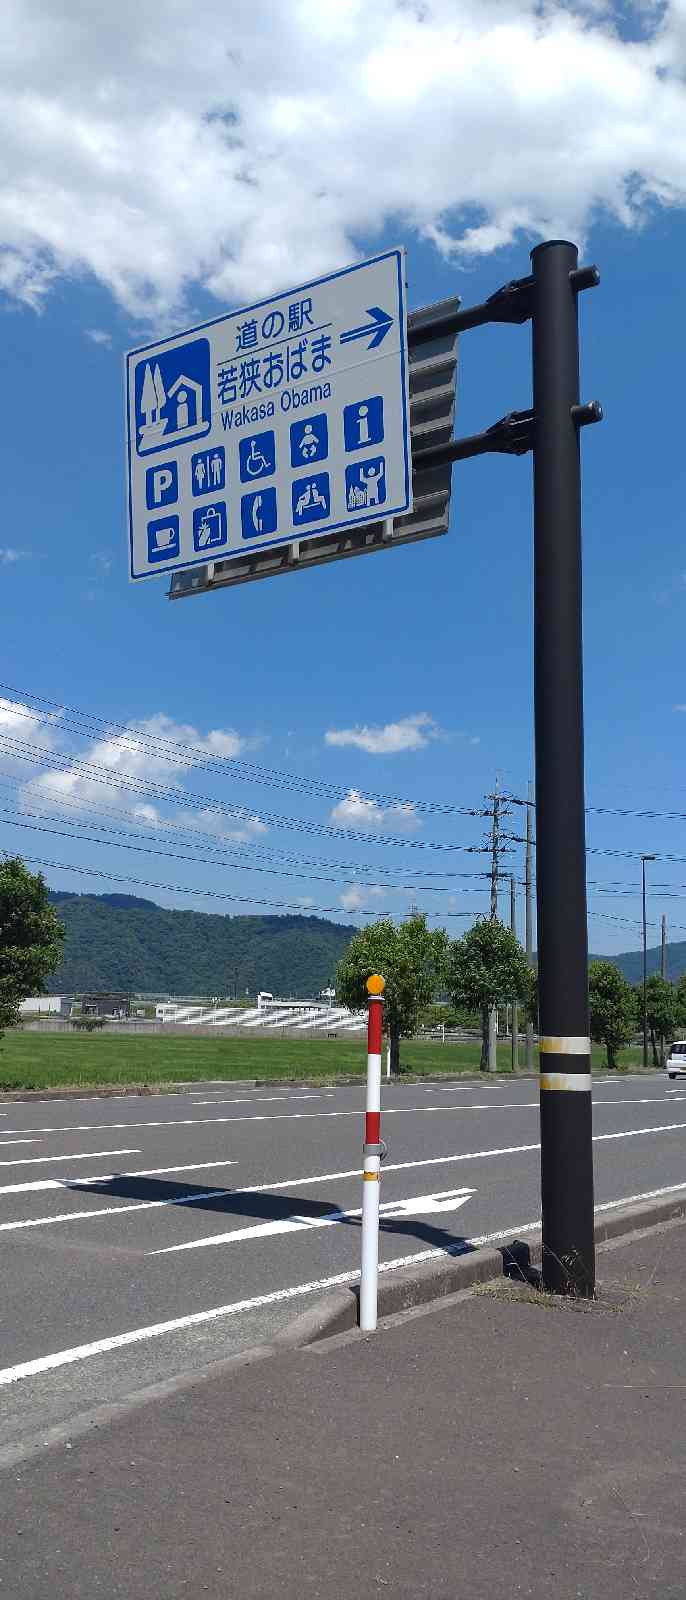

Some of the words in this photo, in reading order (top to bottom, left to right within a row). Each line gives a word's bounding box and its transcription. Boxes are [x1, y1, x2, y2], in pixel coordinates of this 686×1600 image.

[235, 297, 313, 351] 道の駅
[217, 334, 332, 405] 若狭おばま
[221, 400, 275, 431] Wakasa
[280, 381, 332, 413] Obama
